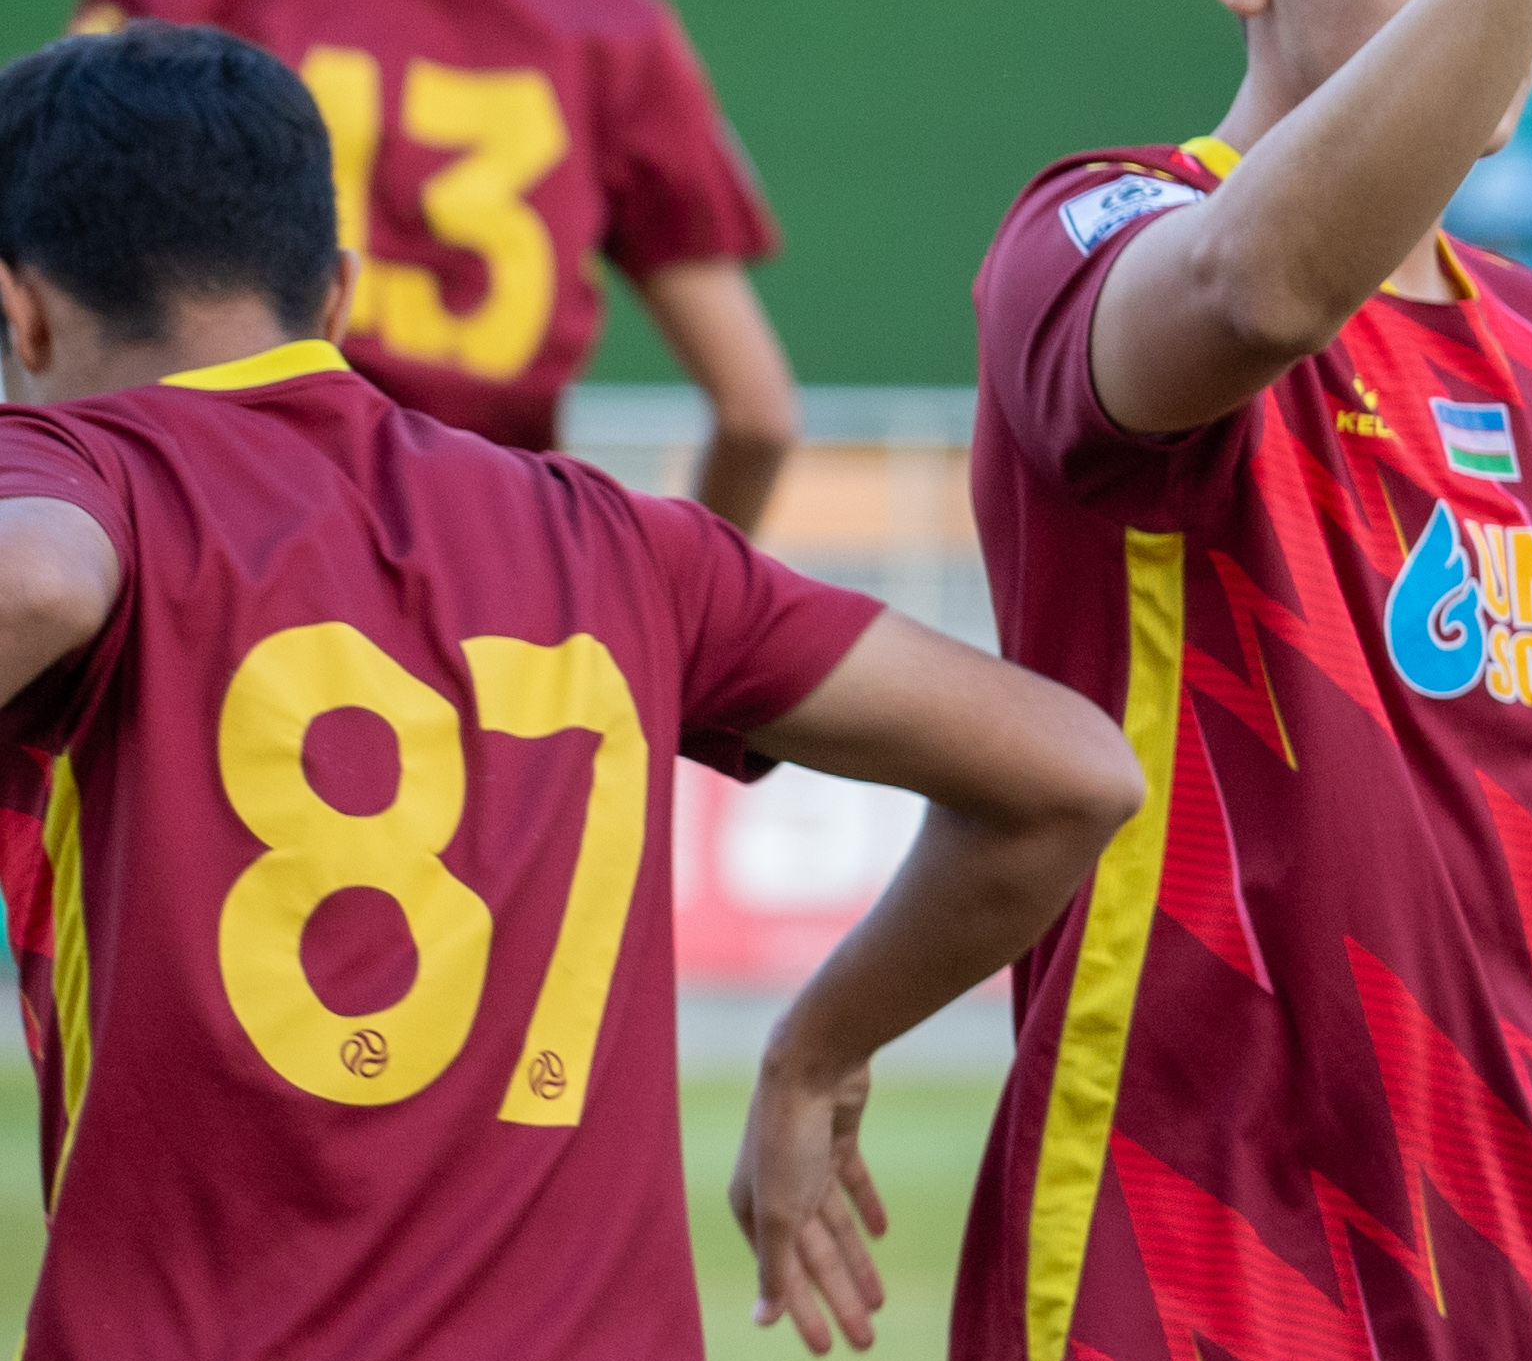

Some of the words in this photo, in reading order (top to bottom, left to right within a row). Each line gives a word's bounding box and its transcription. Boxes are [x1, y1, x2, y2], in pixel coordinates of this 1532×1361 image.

[302, 46, 569, 382] 13
[1336, 408, 1399, 439] KEL
[218, 621, 649, 1127] 87
